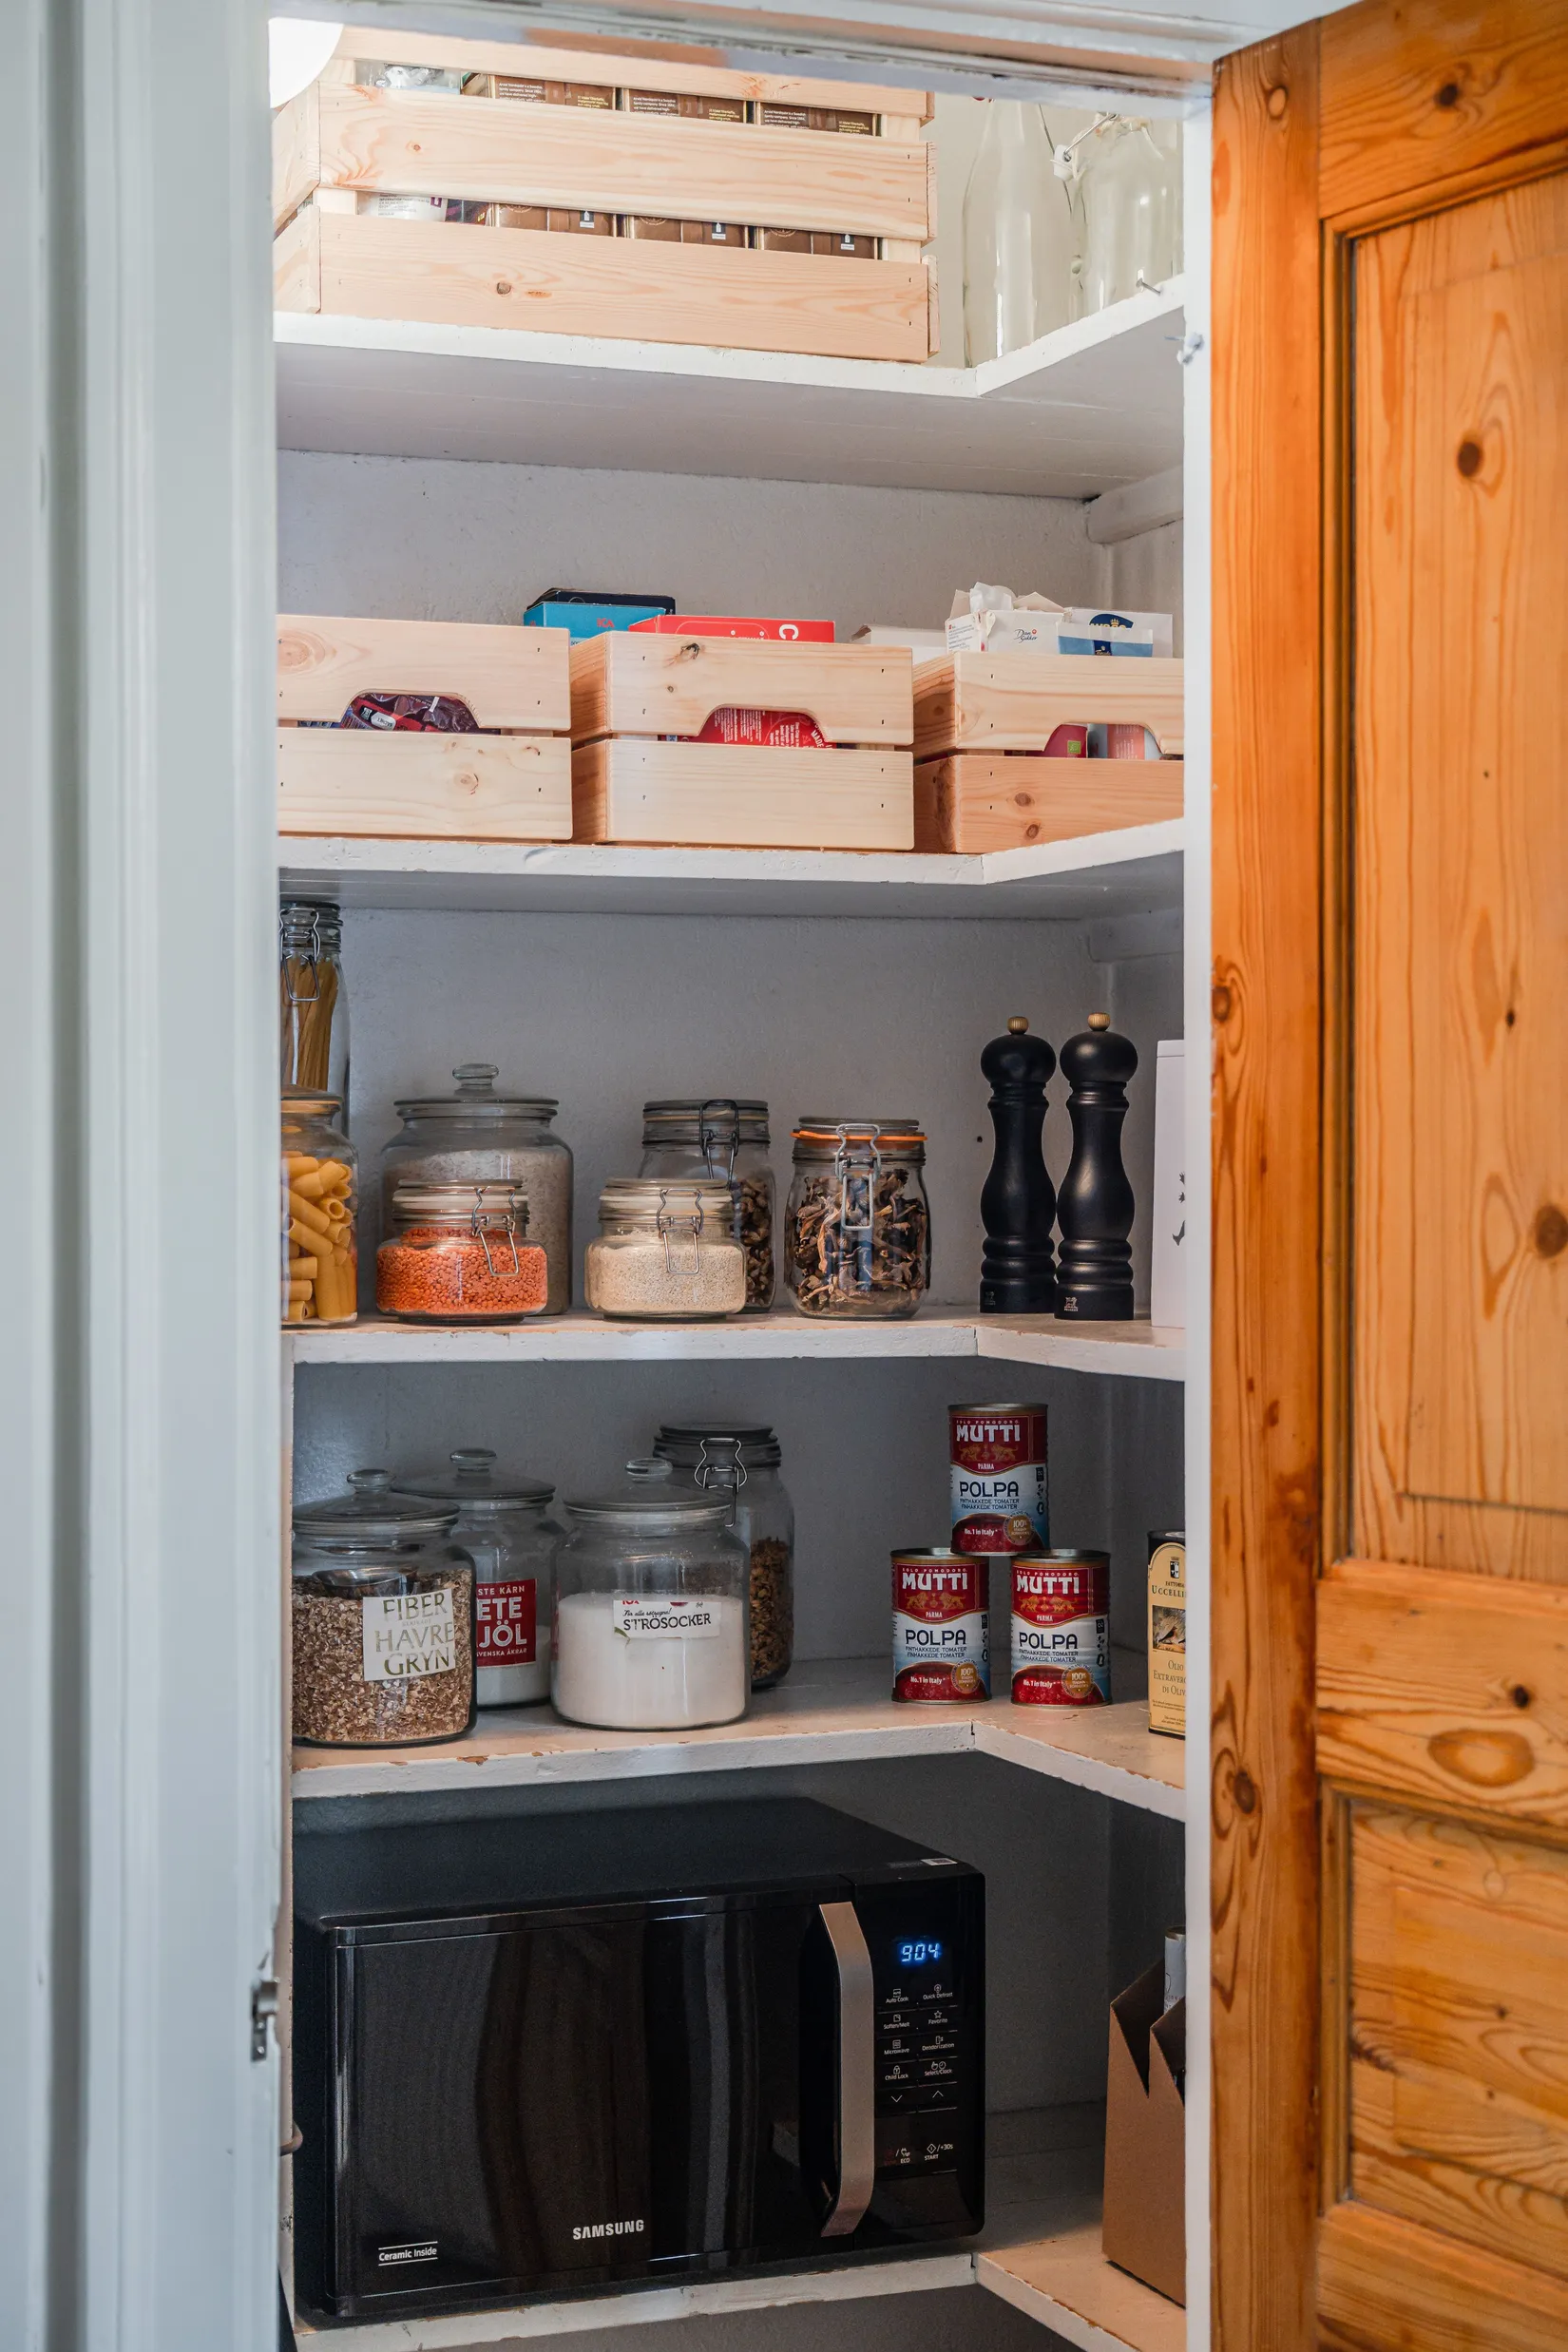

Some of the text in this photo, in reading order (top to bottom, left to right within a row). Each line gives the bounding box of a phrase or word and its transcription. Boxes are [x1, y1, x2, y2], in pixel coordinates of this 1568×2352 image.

[597, 618, 614, 628] ICA
[811, 729, 824, 747] MADE
[956, 1425, 1020, 1442] MUTTI
[959, 1481, 1019, 1497] POLPA
[499, 1585, 525, 1594] KÄRN
[902, 1573, 968, 1591] MUTTI
[1016, 1575, 1079, 1594] MUTTI
[1152, 1585, 1185, 1597] UCCELLI
[383, 1592, 447, 1621] FIBER
[374, 1622, 454, 1652] HAVRE
[478, 1620, 527, 1648] JÖL
[905, 1629, 966, 1646] POLPA
[1019, 1632, 1078, 1649] POLPA
[384, 1647, 449, 1675] GRYN
[1170, 1685, 1186, 1696] OLIV
[901, 1943, 940, 1962] 904
[573, 2219, 644, 2240] SAMSUNG
[379, 2247, 437, 2261] Ceramic Inside
